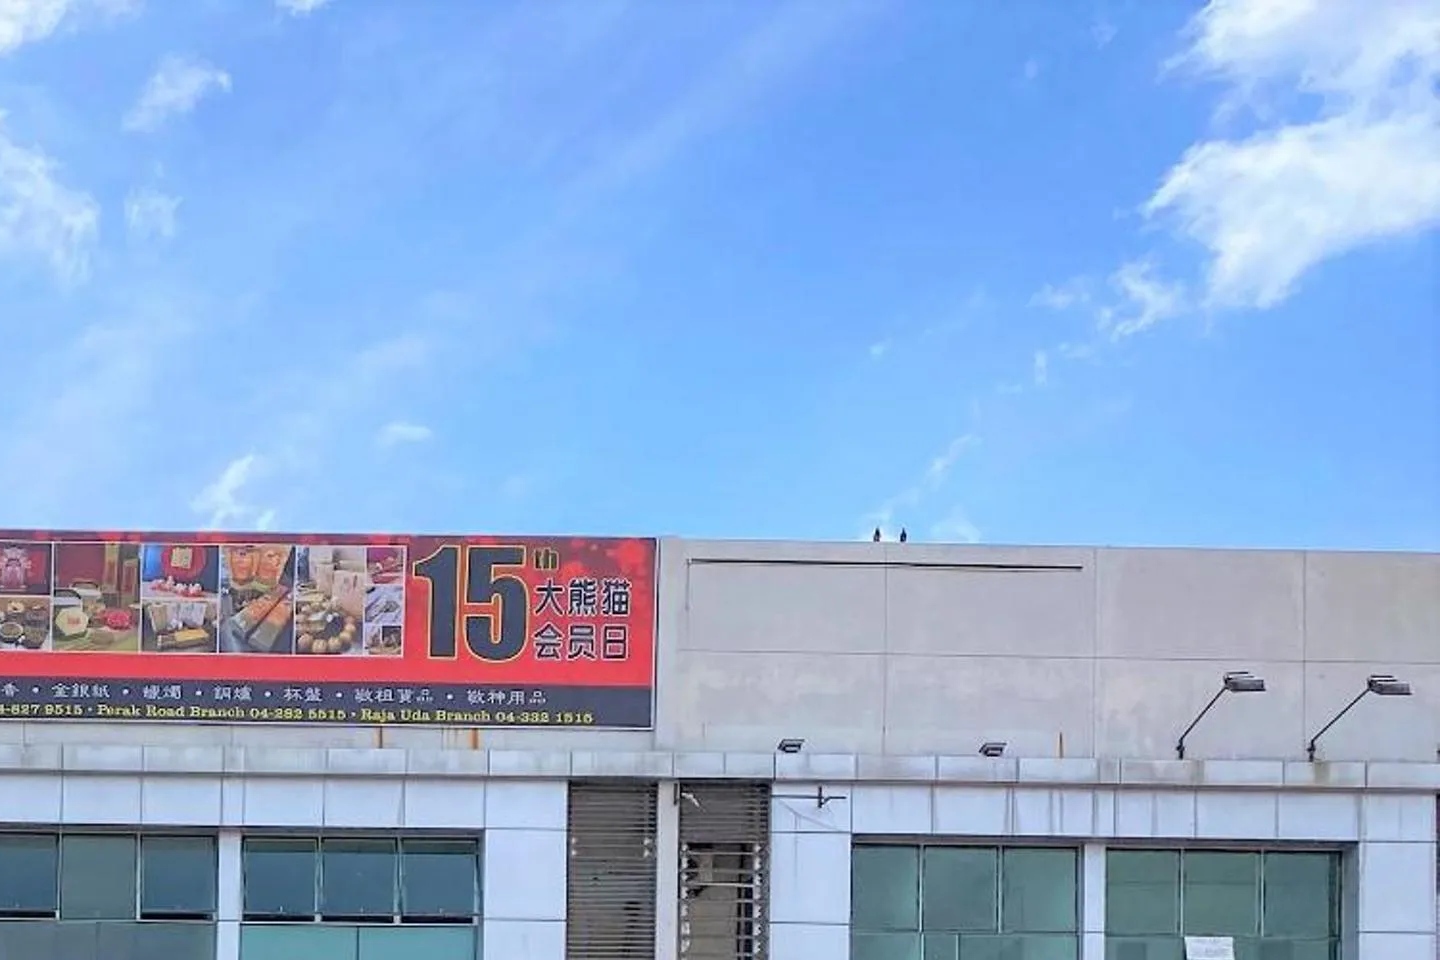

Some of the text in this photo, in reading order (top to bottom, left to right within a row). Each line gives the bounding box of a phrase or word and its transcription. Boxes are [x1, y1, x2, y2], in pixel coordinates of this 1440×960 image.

[533, 577, 632, 616] 大熊猫
[533, 622, 630, 660] 会员日
[97, 704, 140, 717] Perak
[146, 705, 185, 717] Road
[190, 705, 245, 718] Branch
[361, 708, 395, 723] Raja
[401, 709, 430, 721] Uda
[436, 709, 490, 721] Branch
